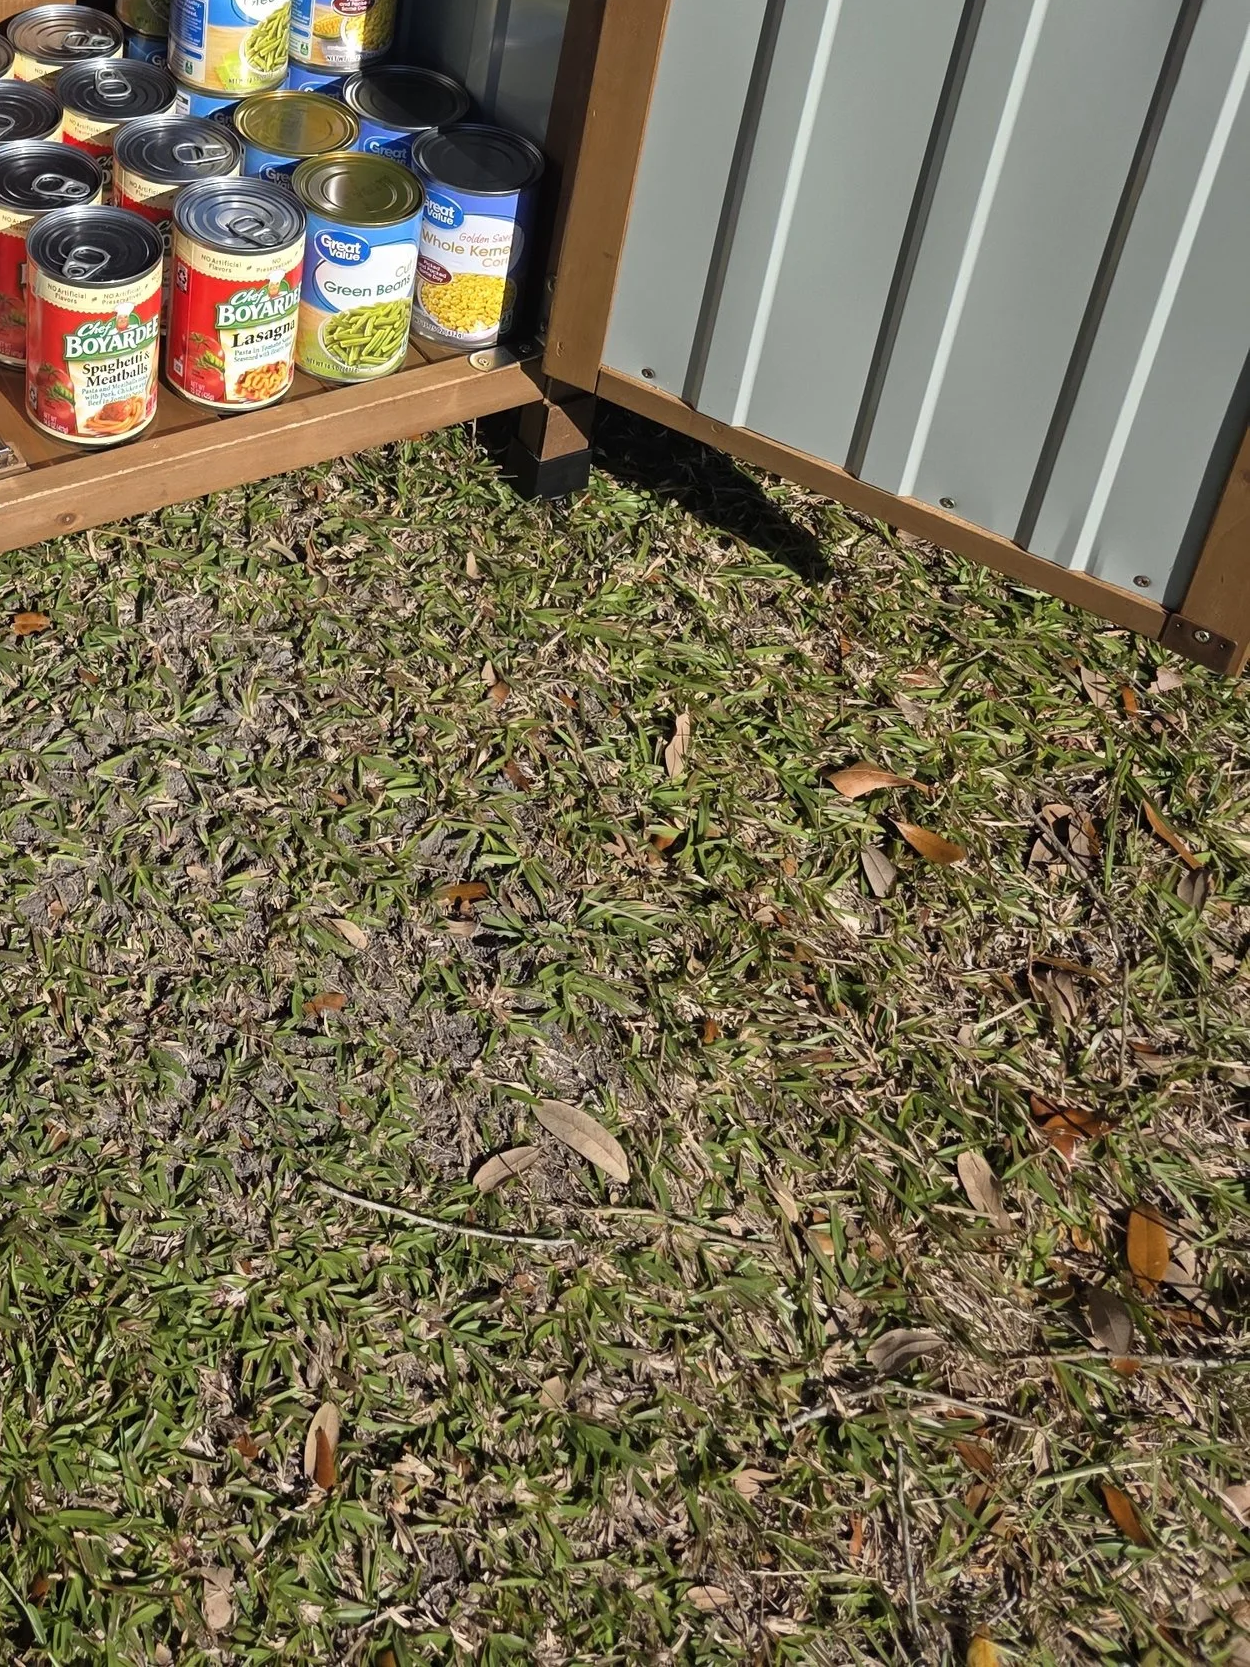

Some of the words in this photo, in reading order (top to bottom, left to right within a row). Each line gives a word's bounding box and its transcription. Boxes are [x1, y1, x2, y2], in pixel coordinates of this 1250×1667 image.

[370, 141, 407, 159] Great
[428, 210, 454, 226] Value
[321, 234, 362, 254] Great
[422, 229, 464, 254] Whole
[470, 245, 511, 256] Kerne
[459, 232, 489, 244] Golden
[330, 247, 360, 262] Value
[395, 260, 412, 278] Cut
[324, 280, 372, 297] Green
[376, 275, 411, 296] Beans
[231, 289, 264, 305] Chef
[65, 316, 159, 358] BOYARDEE
[77, 322, 113, 337] Chef
[231, 319, 295, 348] Lasagna
[82, 354, 143, 375] Spaghetti
[144, 351, 150, 359] &
[86, 363, 148, 388] Meatballs
